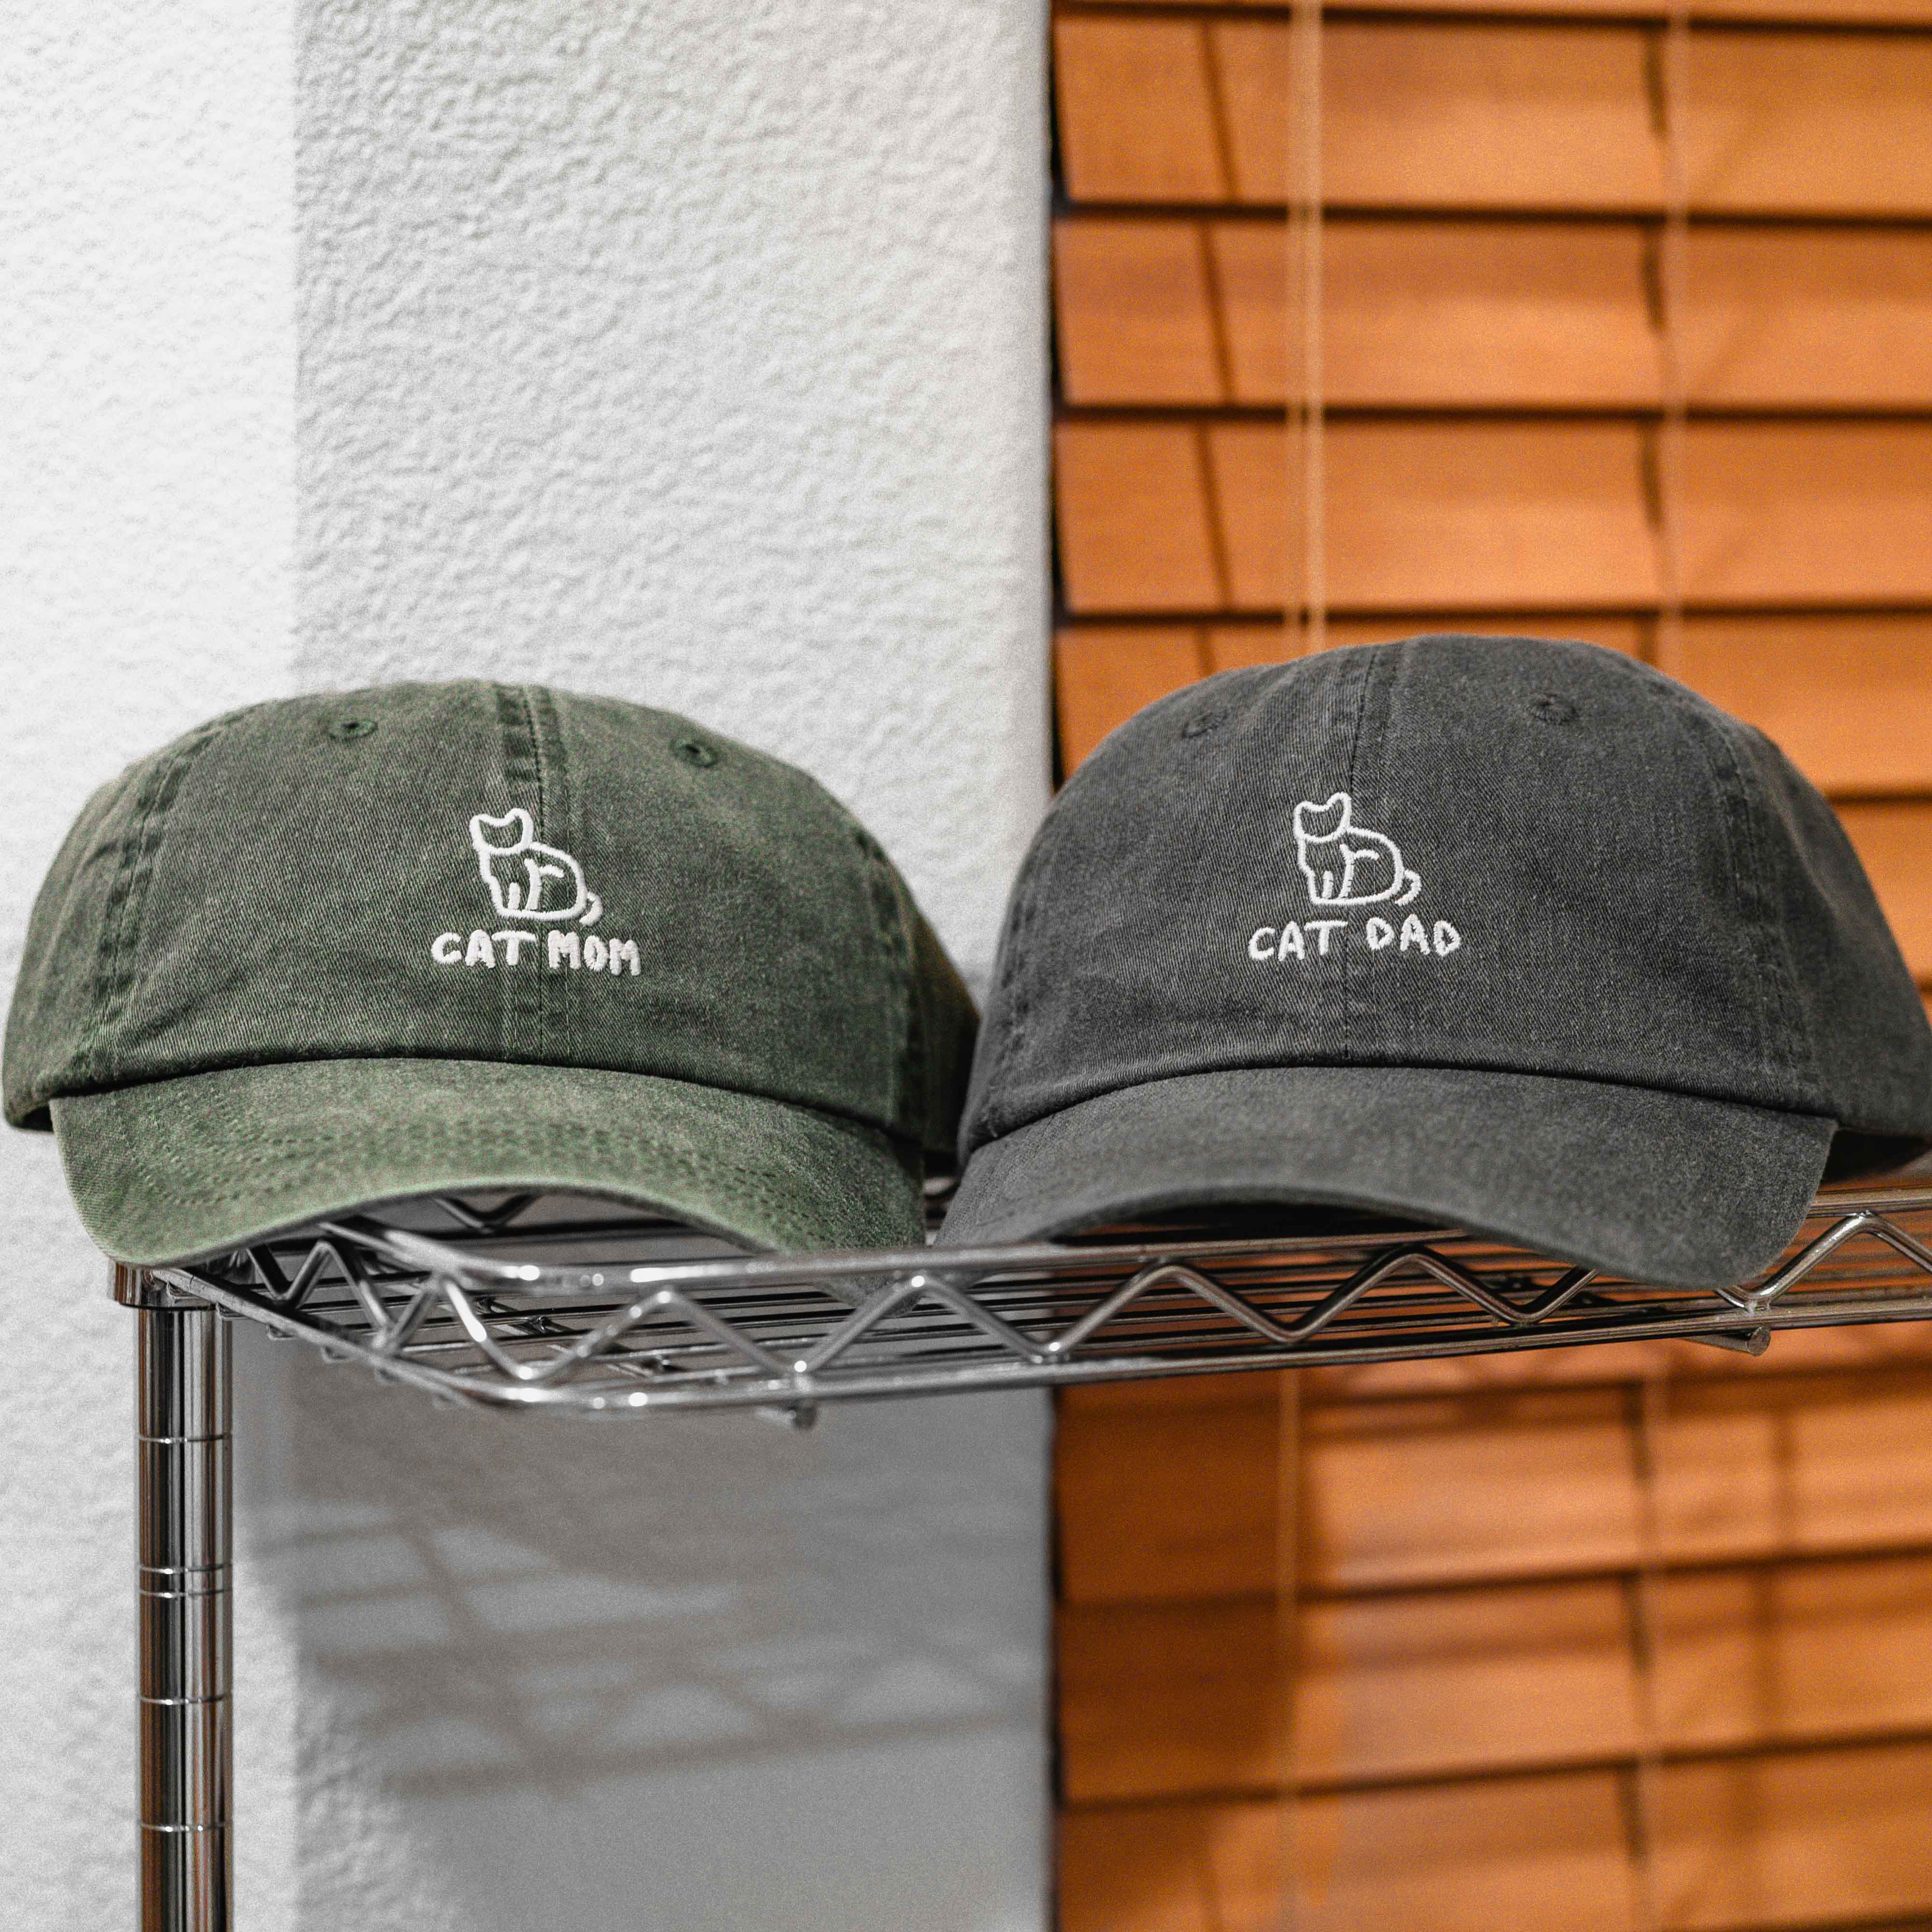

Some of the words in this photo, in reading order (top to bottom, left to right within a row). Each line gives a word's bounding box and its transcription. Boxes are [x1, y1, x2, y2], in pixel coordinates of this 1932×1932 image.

[430, 928, 538, 968] CAT
[547, 929, 640, 976] MOM
[1248, 920, 1348, 962] CAT
[1365, 913, 1462, 957] DAD
